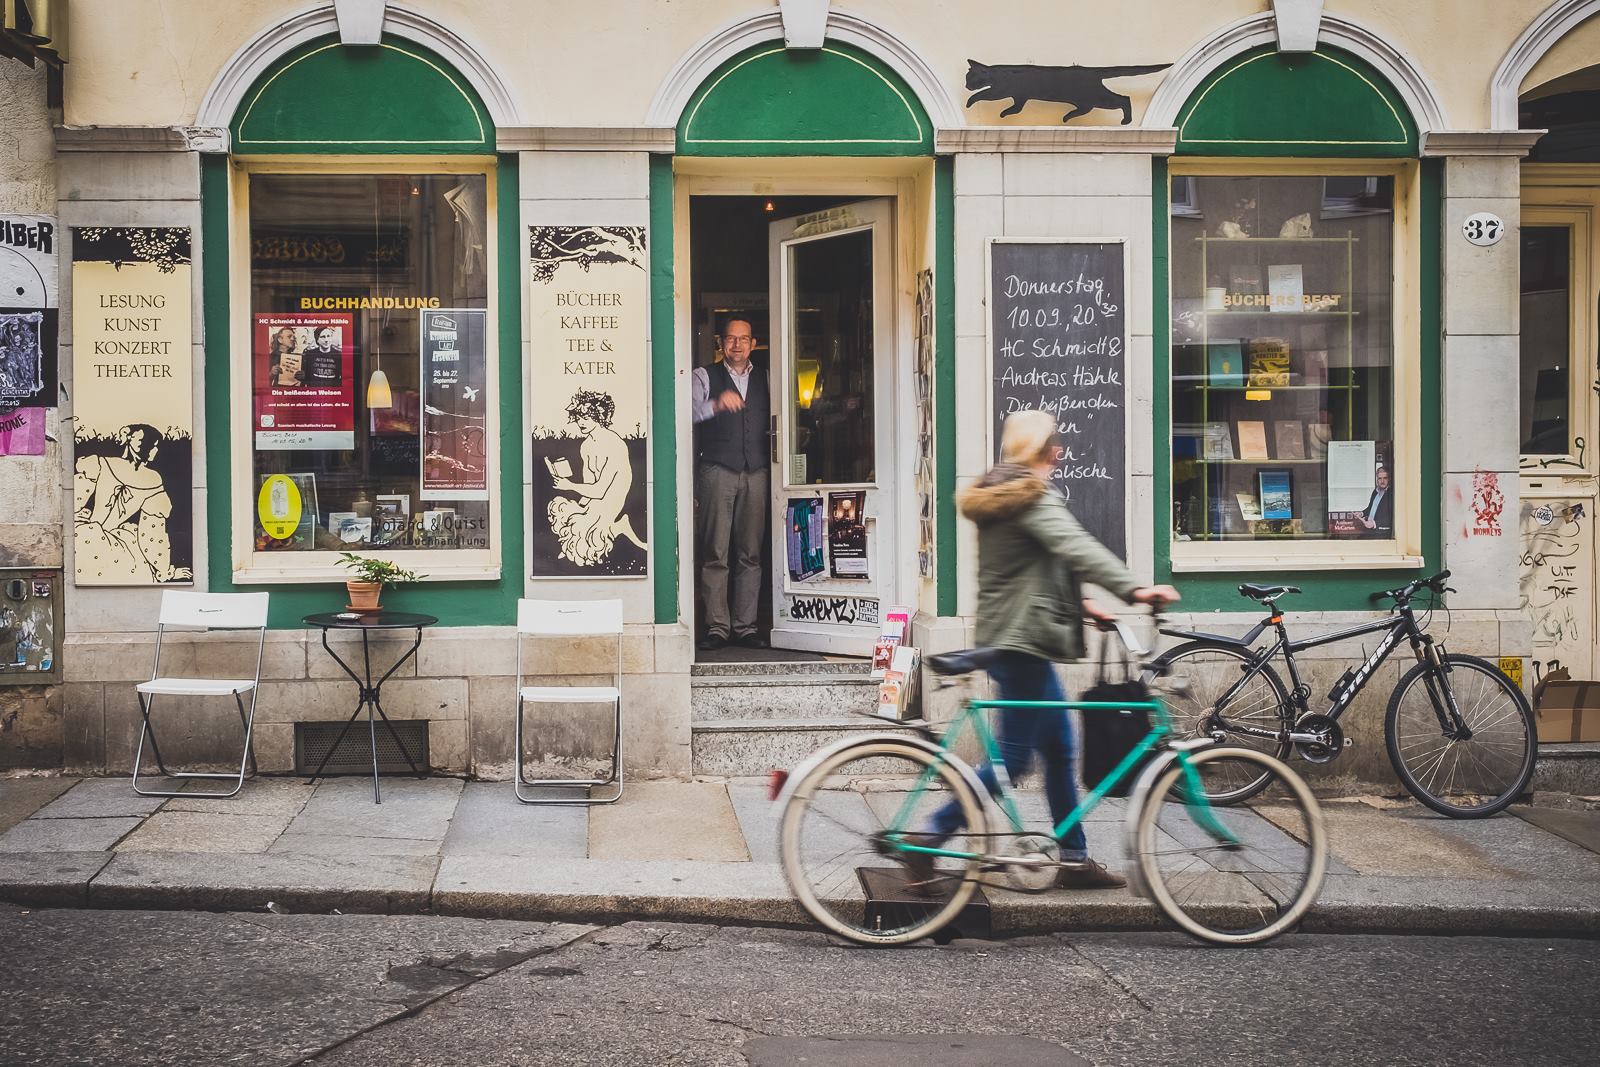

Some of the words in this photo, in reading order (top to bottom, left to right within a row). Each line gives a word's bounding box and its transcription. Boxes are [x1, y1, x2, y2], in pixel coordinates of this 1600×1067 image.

[1468, 220, 1500, 239] 37
[1004, 273, 1111, 306] Donnerstag,
[99, 294, 166, 309] LESUNG
[300, 297, 441, 310] BUCHHANDLUNG
[556, 290, 623, 306] BÜCHER
[1223, 292, 1297, 307] BÜCHERS
[1302, 294, 1342, 306] BEST
[104, 317, 162, 332] KUNST
[560, 316, 619, 329] KAFFEE
[94, 340, 172, 355] KONZERT
[565, 338, 596, 352] TEE
[600, 338, 614, 352] &
[1000, 337, 1025, 358] HC
[1032, 336, 1107, 358] Schmidt
[94, 364, 173, 378] THEATER
[563, 361, 617, 375] KATER
[1001, 366, 1067, 389] Andreas
[1073, 365, 1122, 387] Hähle
[1038, 393, 1119, 422] beißenden
[430, 517, 440, 532] &
[443, 515, 486, 531] Quist
[1473, 528, 1502, 537] MONKEYS
[1340, 631, 1394, 705] STEVENS
